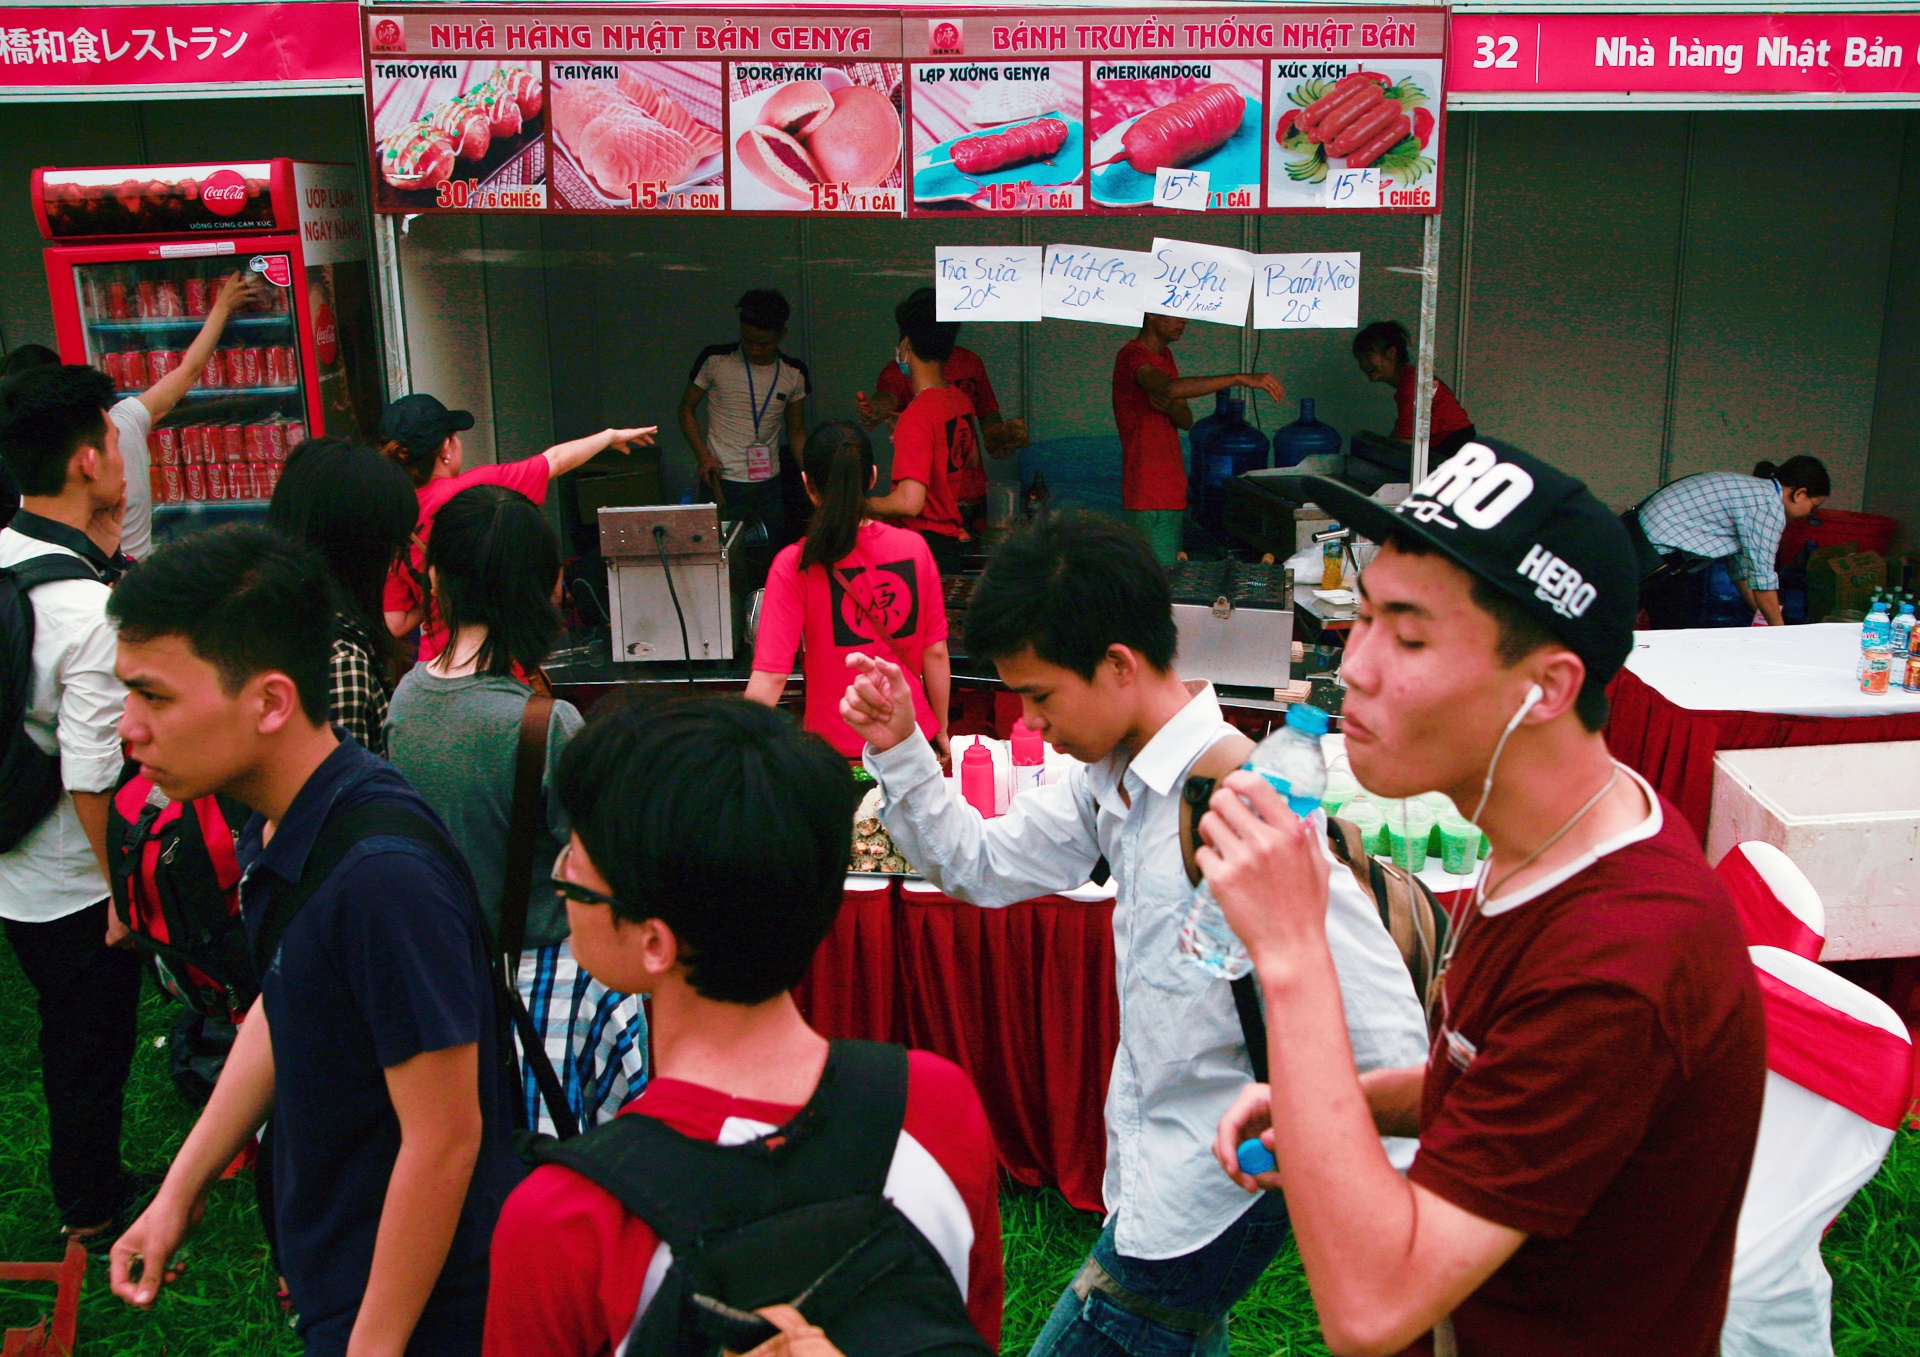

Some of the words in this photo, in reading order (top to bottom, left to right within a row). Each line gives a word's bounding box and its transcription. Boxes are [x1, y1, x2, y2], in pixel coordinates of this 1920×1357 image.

[430, 19, 495, 51] NHÀ
[505, 19, 592, 51] HÀNG
[602, 20, 686, 54] NHẬT
[695, 19, 761, 52] BẢN
[770, 26, 872, 53] GENYA
[992, 20, 1066, 52] BÁNH
[1075, 15, 1175, 52] TRUYỀN
[1183, 15, 1273, 50] THỐNG
[1282, 18, 1354, 52] NHẬT
[1361, 15, 1417, 50] BẢN
[0, 26, 248, 65] 橋和食レストラン
[1473, 35, 1519, 68] 32
[1595, 36, 1655, 67] Nhà
[1669, 36, 1743, 74] hàng
[1756, 35, 1831, 74] Nhật
[1844, 36, 1903, 67] Bản
[375, 64, 457, 80] TAKOYAKI
[554, 65, 619, 80] TAIYAKI
[736, 66, 822, 81] DORAYAKI
[950, 63, 999, 82] XƯỞNG
[1004, 66, 1050, 82] GENYA
[1096, 65, 1211, 81] AMERIKANDOGU
[1277, 62, 1308, 78] XÚC
[1312, 61, 1347, 79] XÍCH
[500, 188, 541, 208] CHIẾC
[690, 193, 719, 208] CON
[872, 192, 895, 210] CÁI
[1049, 191, 1073, 208] CÁI
[1227, 189, 1251, 208] CÁI
[1389, 185, 1431, 206] CHIẾC
[1516, 543, 1598, 619] HERO
